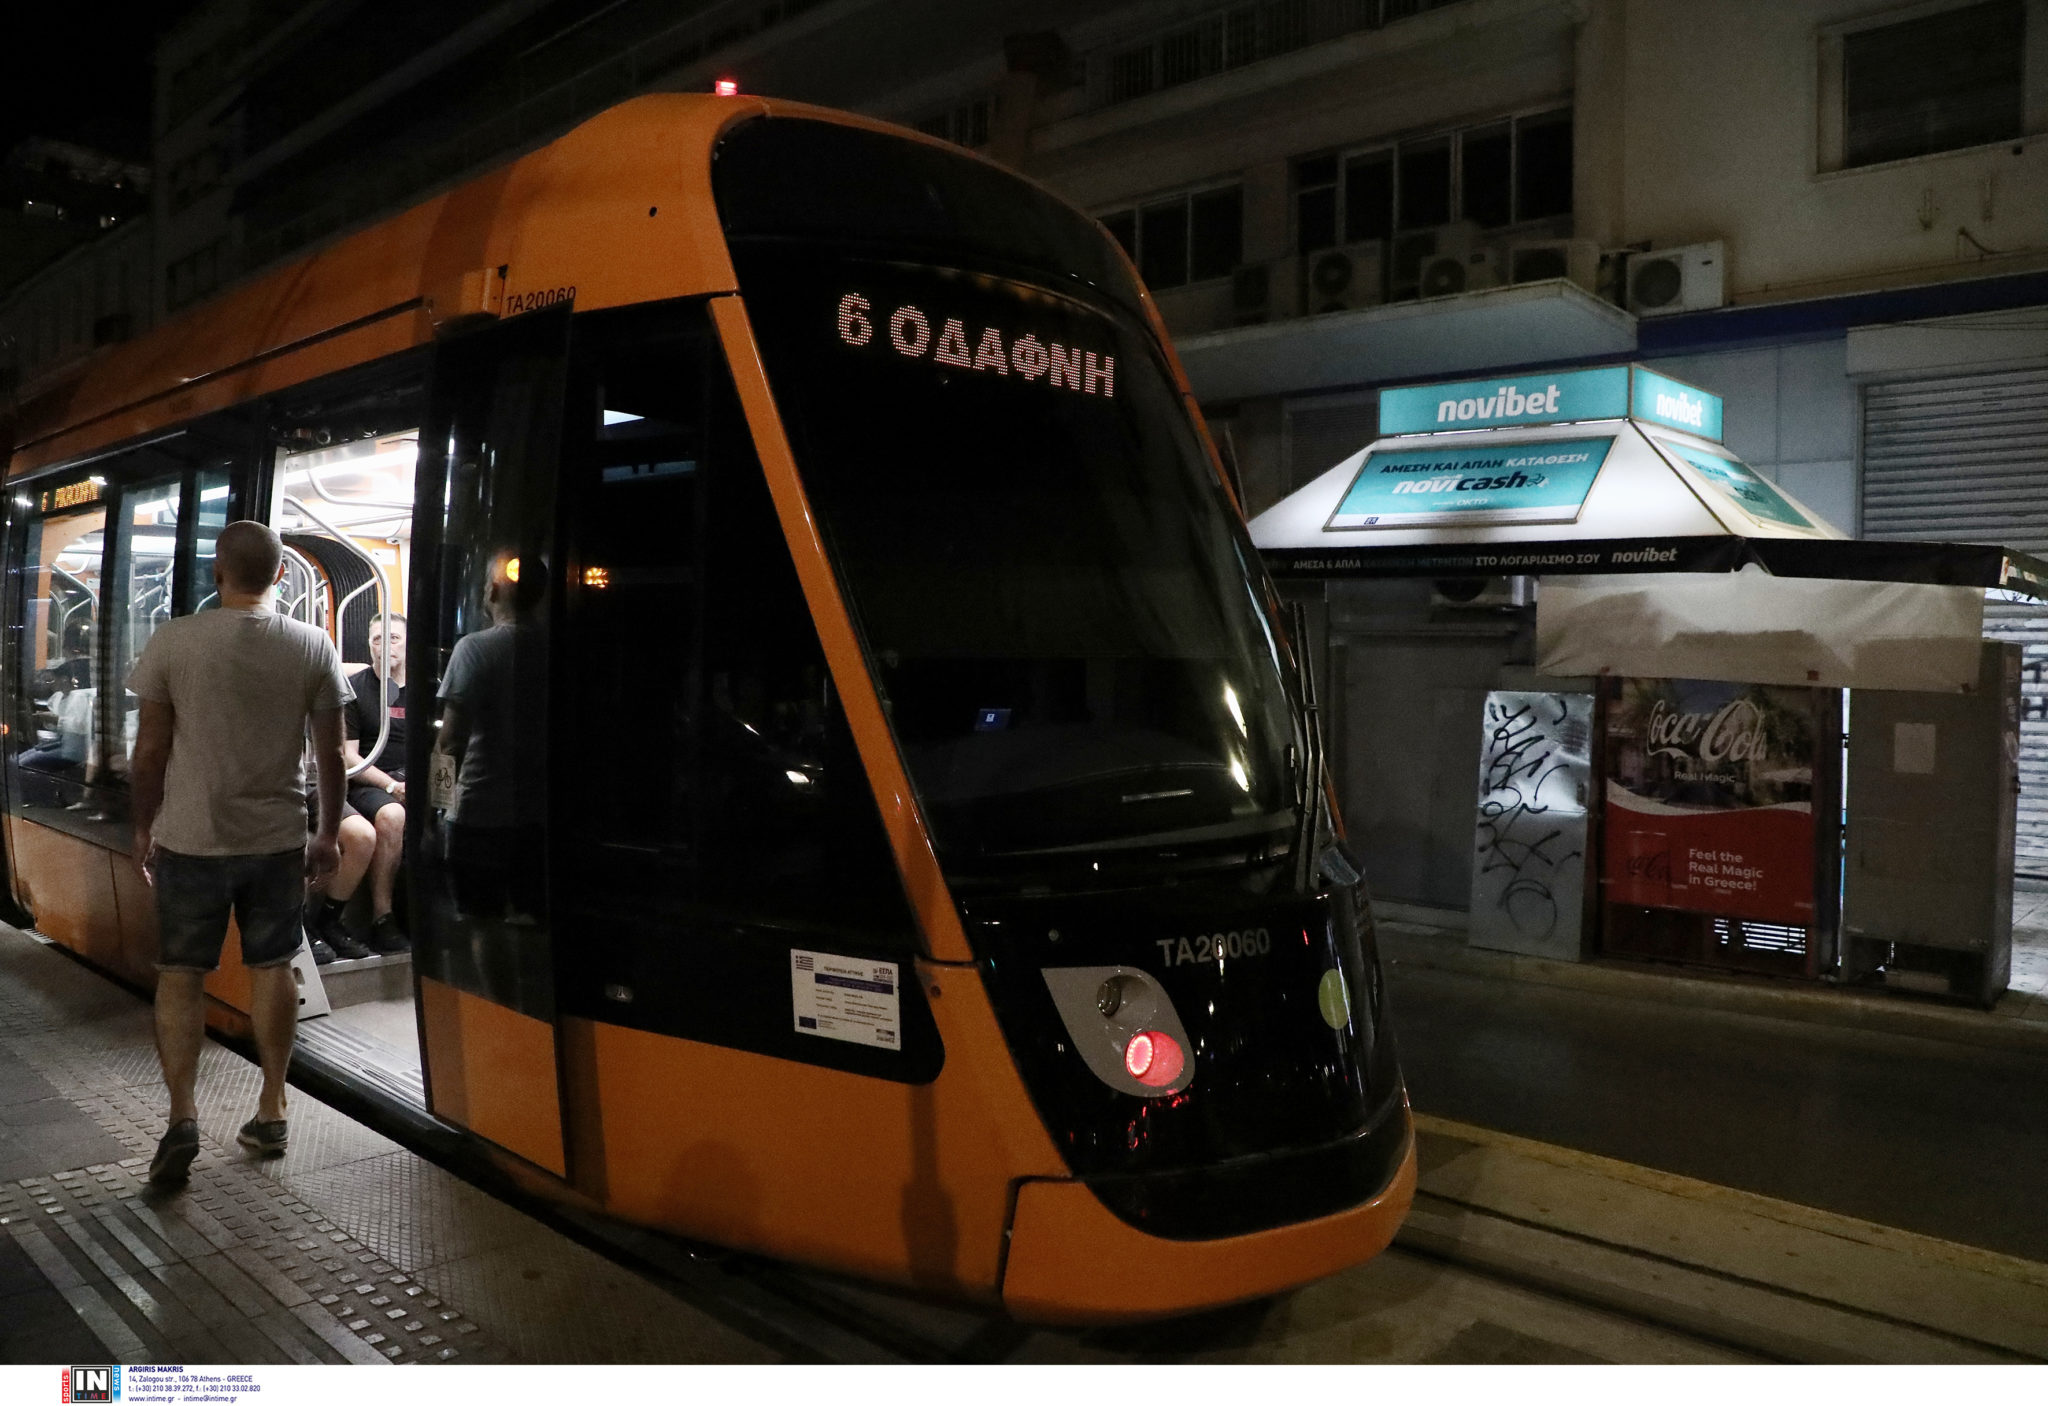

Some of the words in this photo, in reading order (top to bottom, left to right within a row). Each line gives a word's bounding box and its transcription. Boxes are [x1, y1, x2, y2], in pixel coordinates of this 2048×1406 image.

[506, 286, 577, 314] TA20060
[838, 292, 873, 346] 6
[1437, 384, 1560, 422] novibet
[1656, 391, 1703, 427] novibet
[1380, 463, 1431, 474] ΑΜΕΣΗ
[1432, 461, 1459, 471] ΚΑΙ
[1461, 459, 1504, 470] ΑΠΛΗ
[1505, 453, 1590, 467] ΚΑΤΑΘΕΣΗ
[1293, 560, 1325, 569] ΑΜΕΣΑ
[1334, 559, 1361, 569] ΑΠΛΑ
[1475, 556, 1497, 566] ΣΤΟ
[1500, 554, 1574, 566] ΛΟΓΑΡΙΑΣΜΟ
[1576, 553, 1600, 565] ΣΟΥ
[1611, 547, 1678, 563] novibet
[1674, 771, 1698, 780] Real
[1700, 772, 1736, 783] Magic
[1688, 849, 1716, 862] Feel
[1719, 851, 1743, 863] the
[1688, 861, 1719, 874] Real
[1722, 864, 1763, 879] Magic
[1688, 874, 1700, 885] in
[1704, 876, 1757, 891] Greece!
[1156, 927, 1271, 967] TA20060
